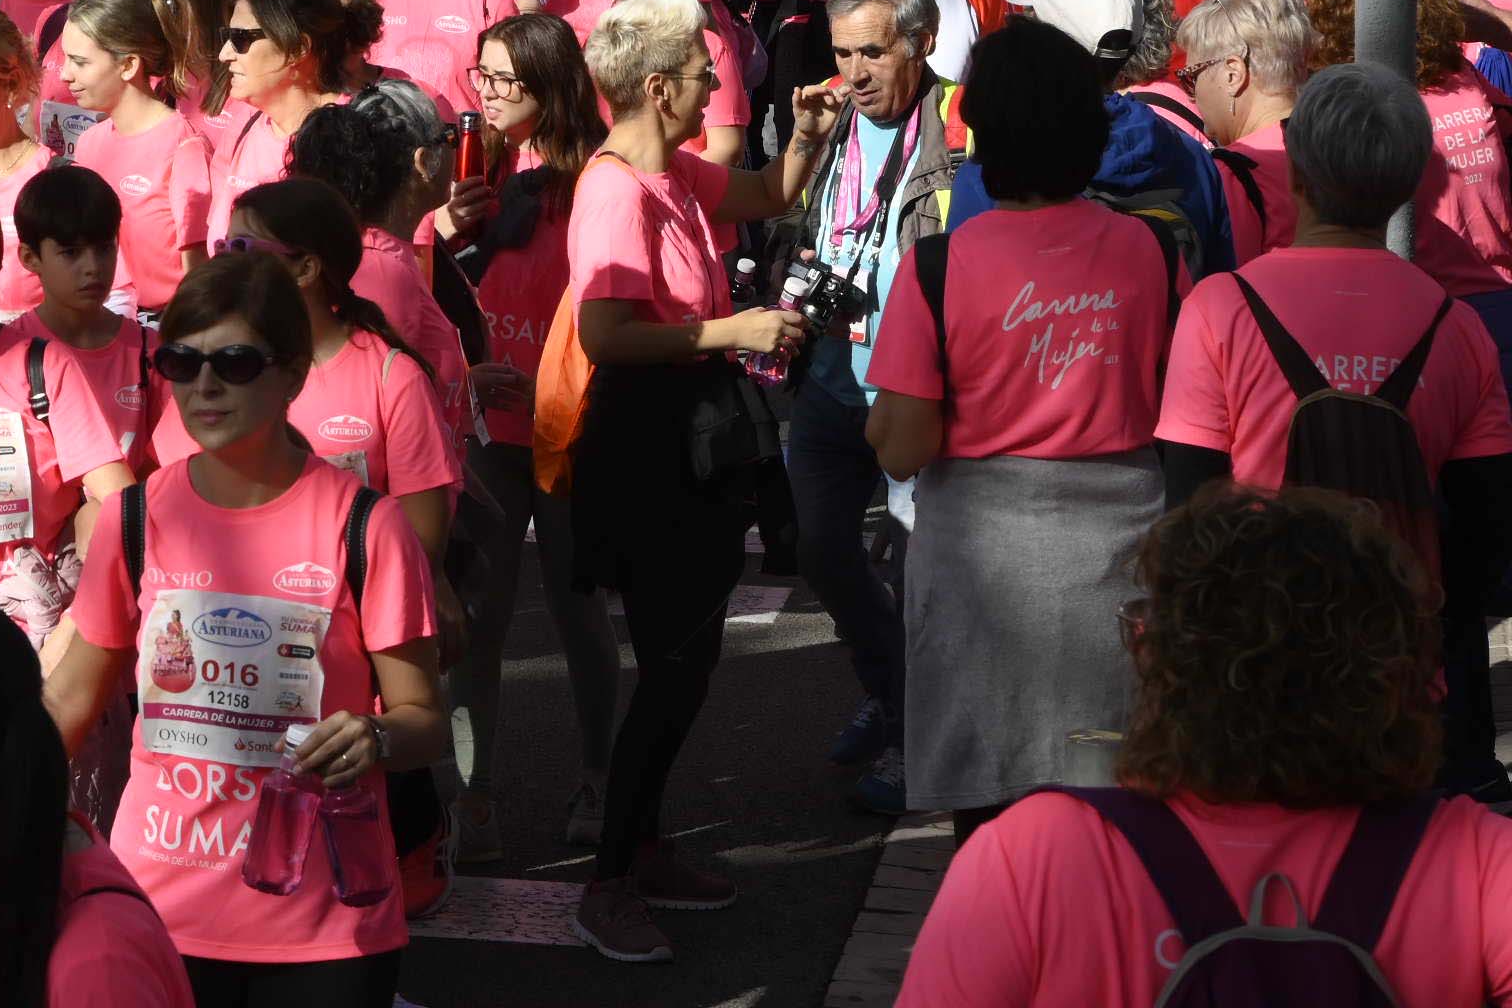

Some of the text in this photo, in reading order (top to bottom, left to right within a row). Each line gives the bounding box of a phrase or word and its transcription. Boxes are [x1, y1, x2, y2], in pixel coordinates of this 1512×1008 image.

[1445, 128, 1487, 151] DE LA
[1446, 147, 1495, 169] MUJER
[1002, 281, 1122, 331] Carrera
[1024, 323, 1105, 390] Mujer
[198, 617, 266, 641] ASTURIANA
[280, 622, 315, 633] SUMA
[201, 659, 260, 687] 016
[208, 690, 250, 709] 12158
[162, 707, 275, 728] CARRERA DE LA MUJER
[159, 727, 208, 746] OYSHO
[247, 737, 273, 752] Sant
[144, 804, 255, 858] SUMA
